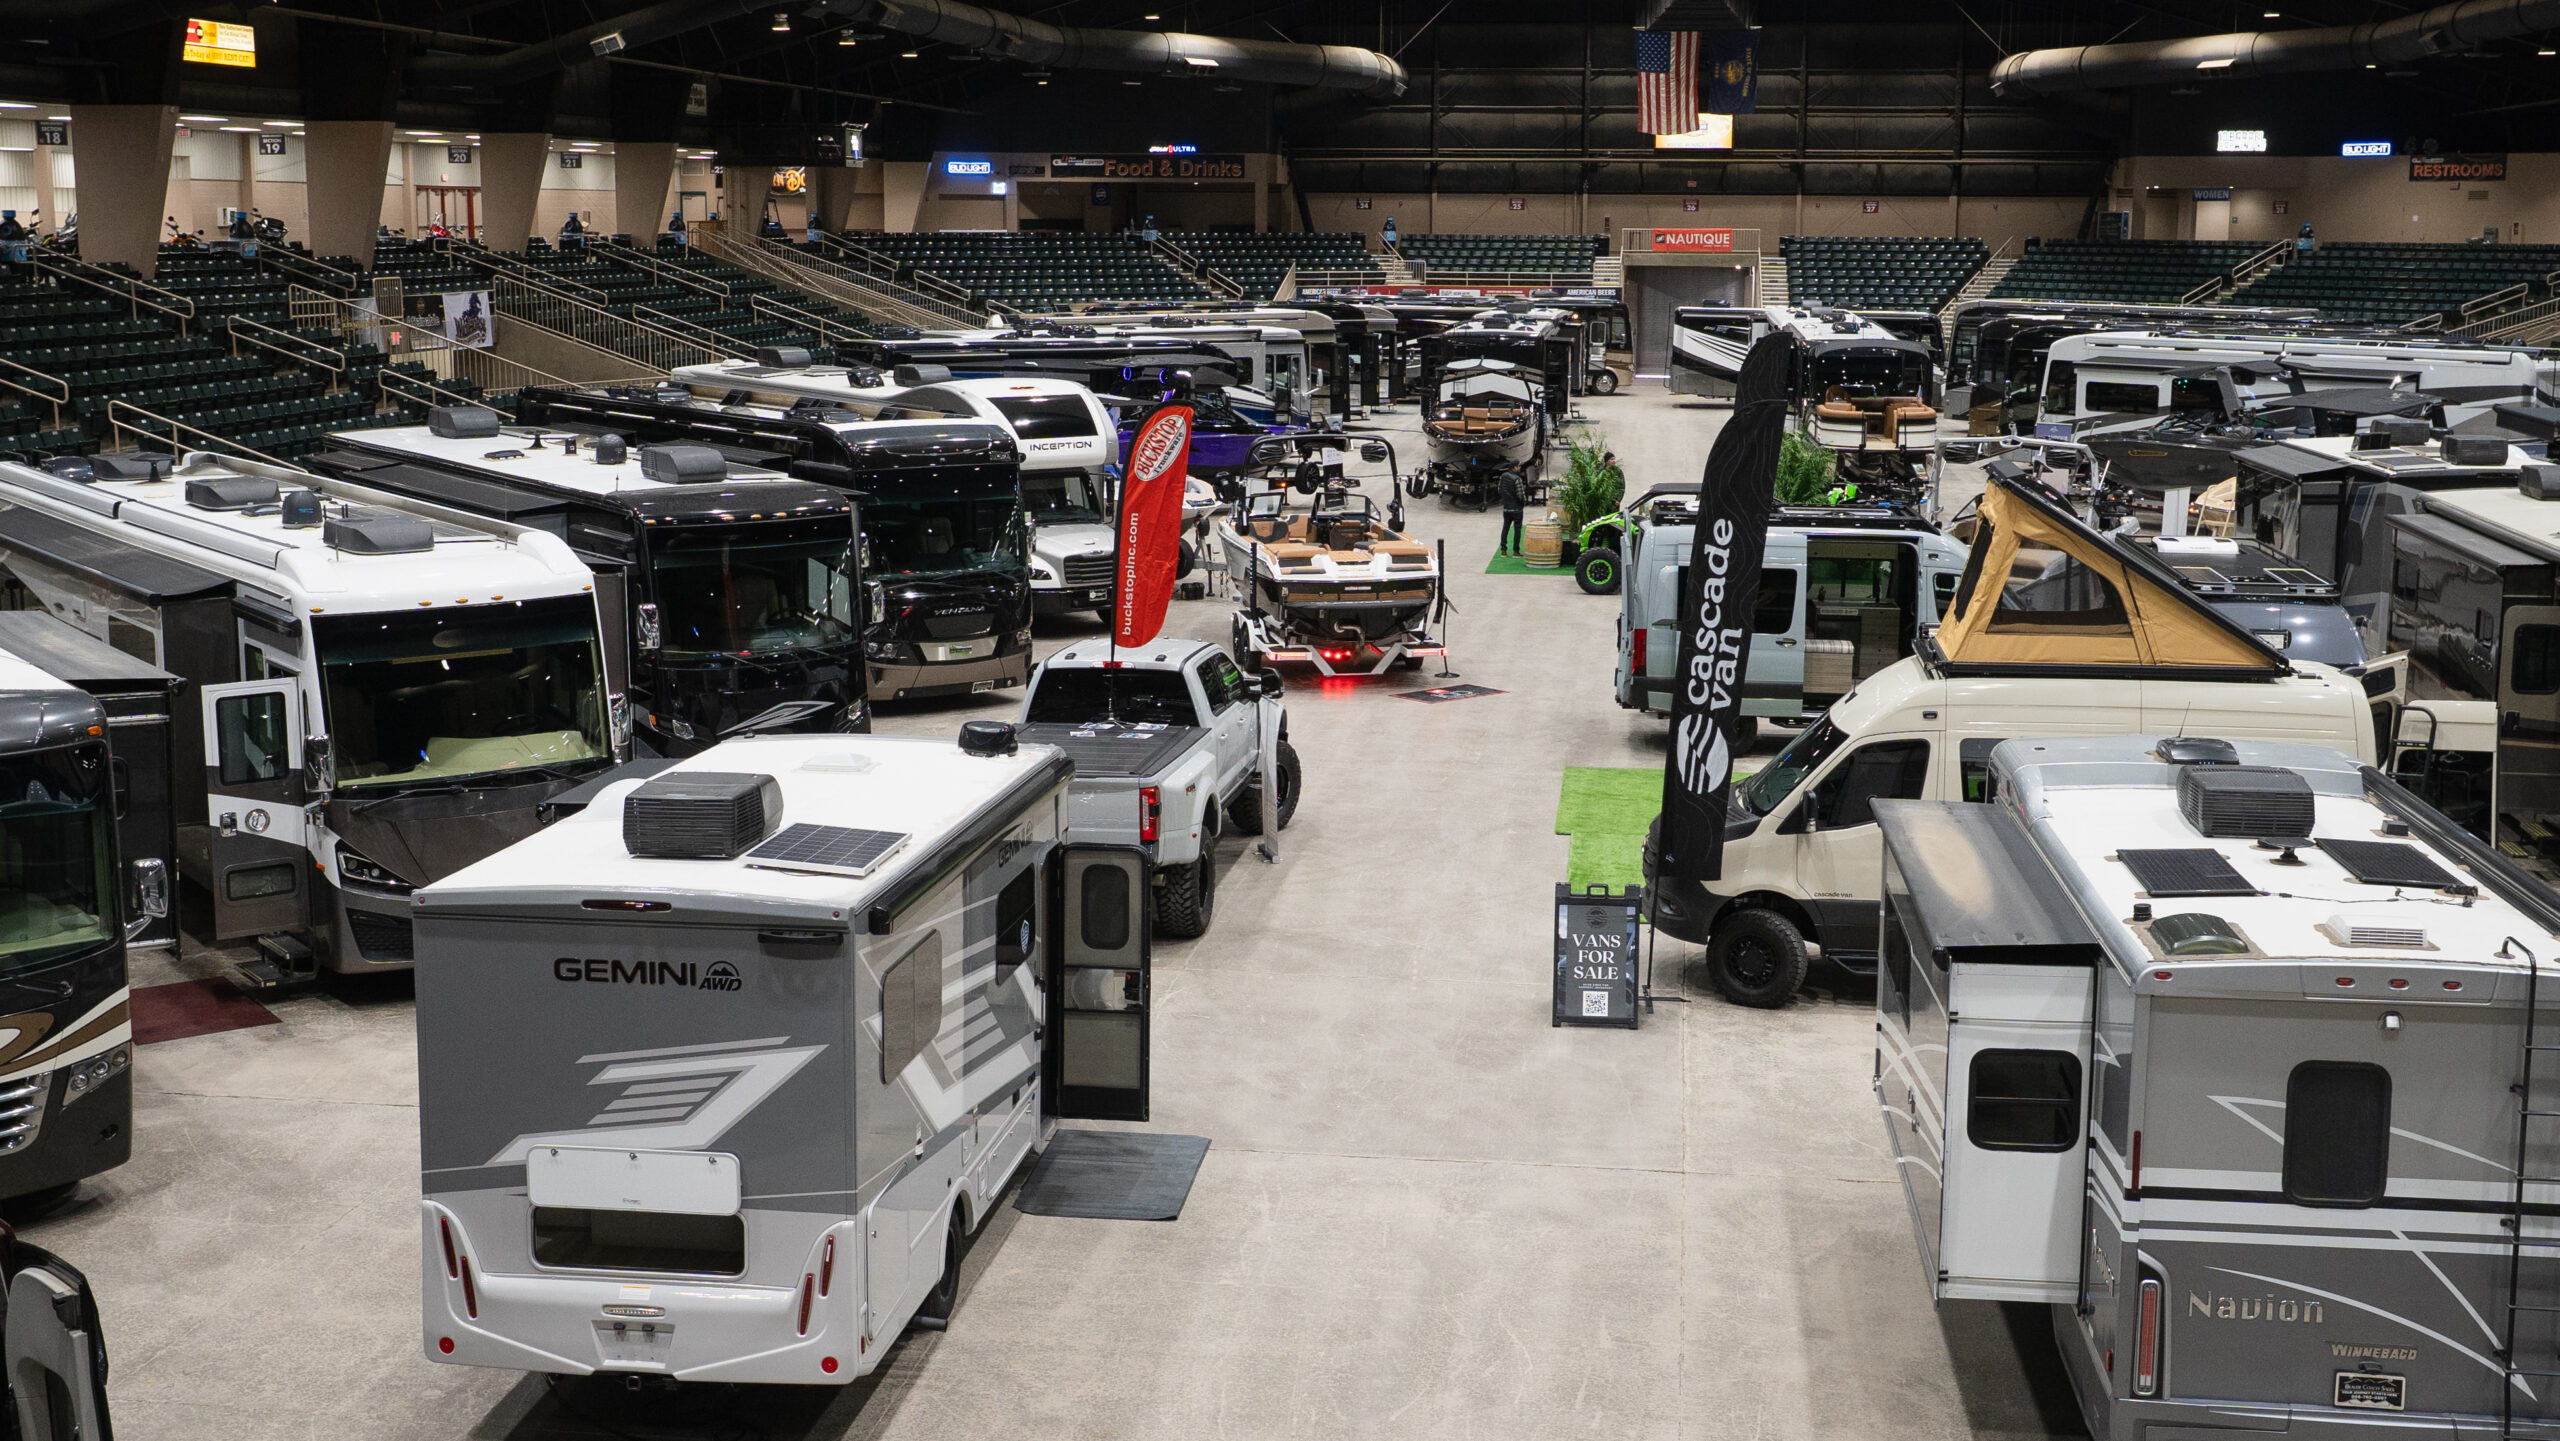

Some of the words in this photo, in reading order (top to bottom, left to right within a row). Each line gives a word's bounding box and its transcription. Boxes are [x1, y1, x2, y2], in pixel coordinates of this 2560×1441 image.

[45, 132, 61, 144] 18
[266, 143, 280, 154] 19
[453, 153, 466, 162] 20
[565, 159, 576, 167] 21
[967, 163, 988, 172] LIGHT
[1105, 160, 1153, 177] Food
[1159, 160, 1174, 177] &
[1179, 160, 1242, 177] Drinks
[2413, 164, 2503, 177] RESTROOMS
[2194, 190, 2229, 199] WOMEN
[1666, 233, 1730, 245] NAUTIQUE
[1029, 441, 1092, 451] INCEPTION
[1137, 418, 1178, 476] BUCKSTOP
[1154, 431, 1184, 474] Truckware
[1122, 512, 1139, 636] buckstopinc.com
[934, 605, 985, 616] VENTANA
[1688, 518, 1733, 705] cascade
[1710, 628, 1743, 711] van
[1572, 933, 1621, 948] VANS
[1578, 949, 1615, 963] FOR
[553, 957, 697, 986] GEMINI
[698, 977, 743, 992] AWD
[1573, 965, 1619, 980] SALE
[2188, 1289, 2324, 1324] Navion
[2331, 1344, 2418, 1361] WINNEBAGO
